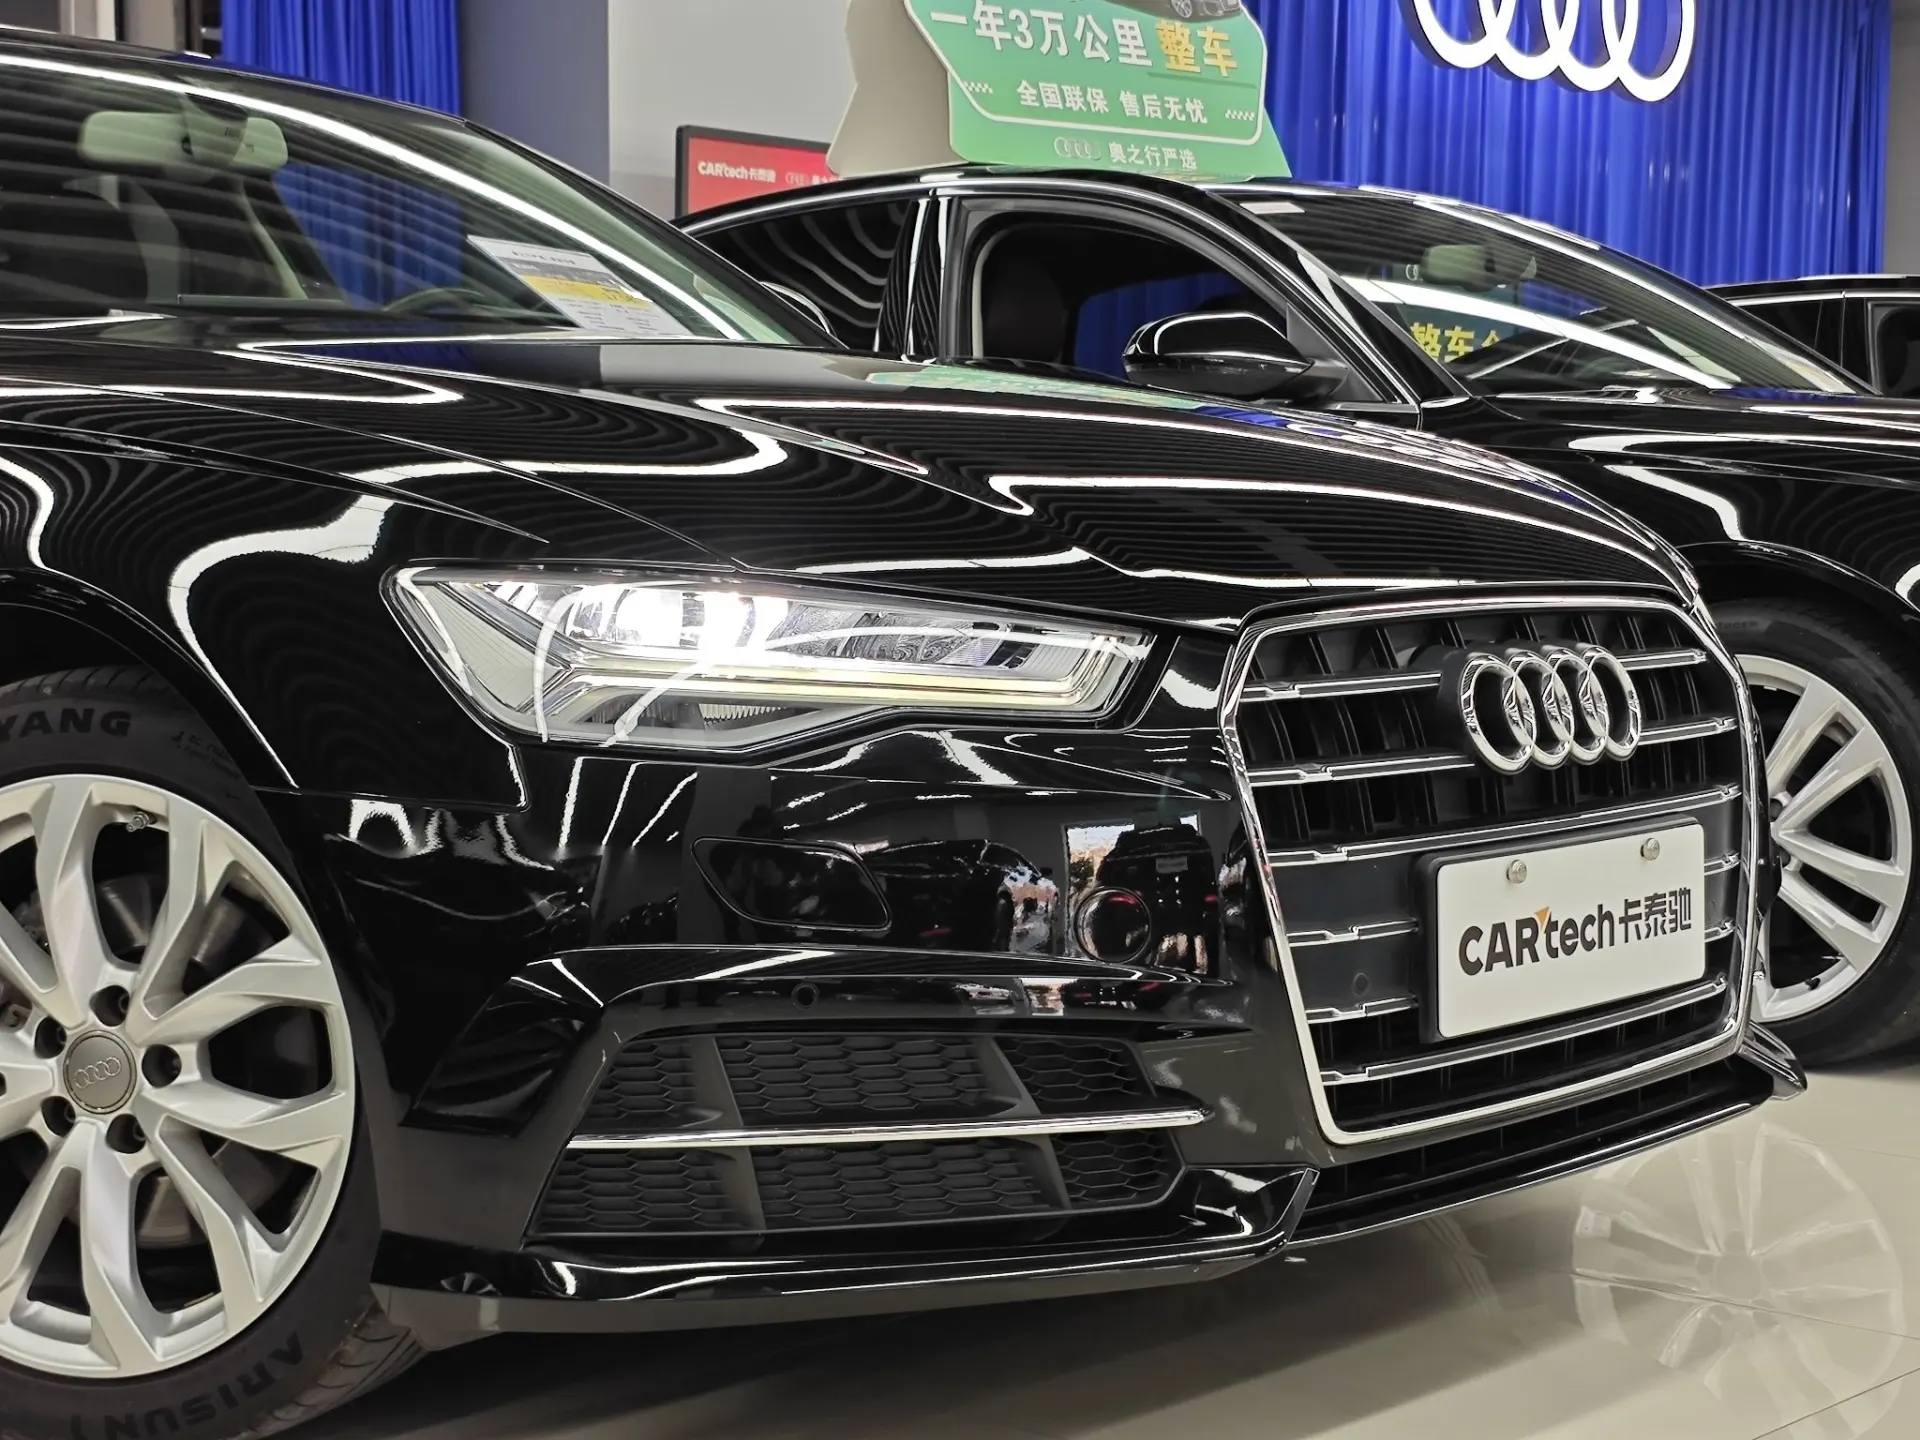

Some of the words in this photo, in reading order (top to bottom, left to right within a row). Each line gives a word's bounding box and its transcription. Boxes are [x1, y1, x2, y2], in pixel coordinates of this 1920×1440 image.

[930, 0, 1152, 67] 一年3万公里
[1155, 18, 1238, 77] 整车
[1017, 80, 1109, 114] 全国联保
[1119, 90, 1208, 125] 售后无忧
[1108, 142, 1198, 171] 奥之行严选
[102, 1330, 304, 1440] ARISUN
